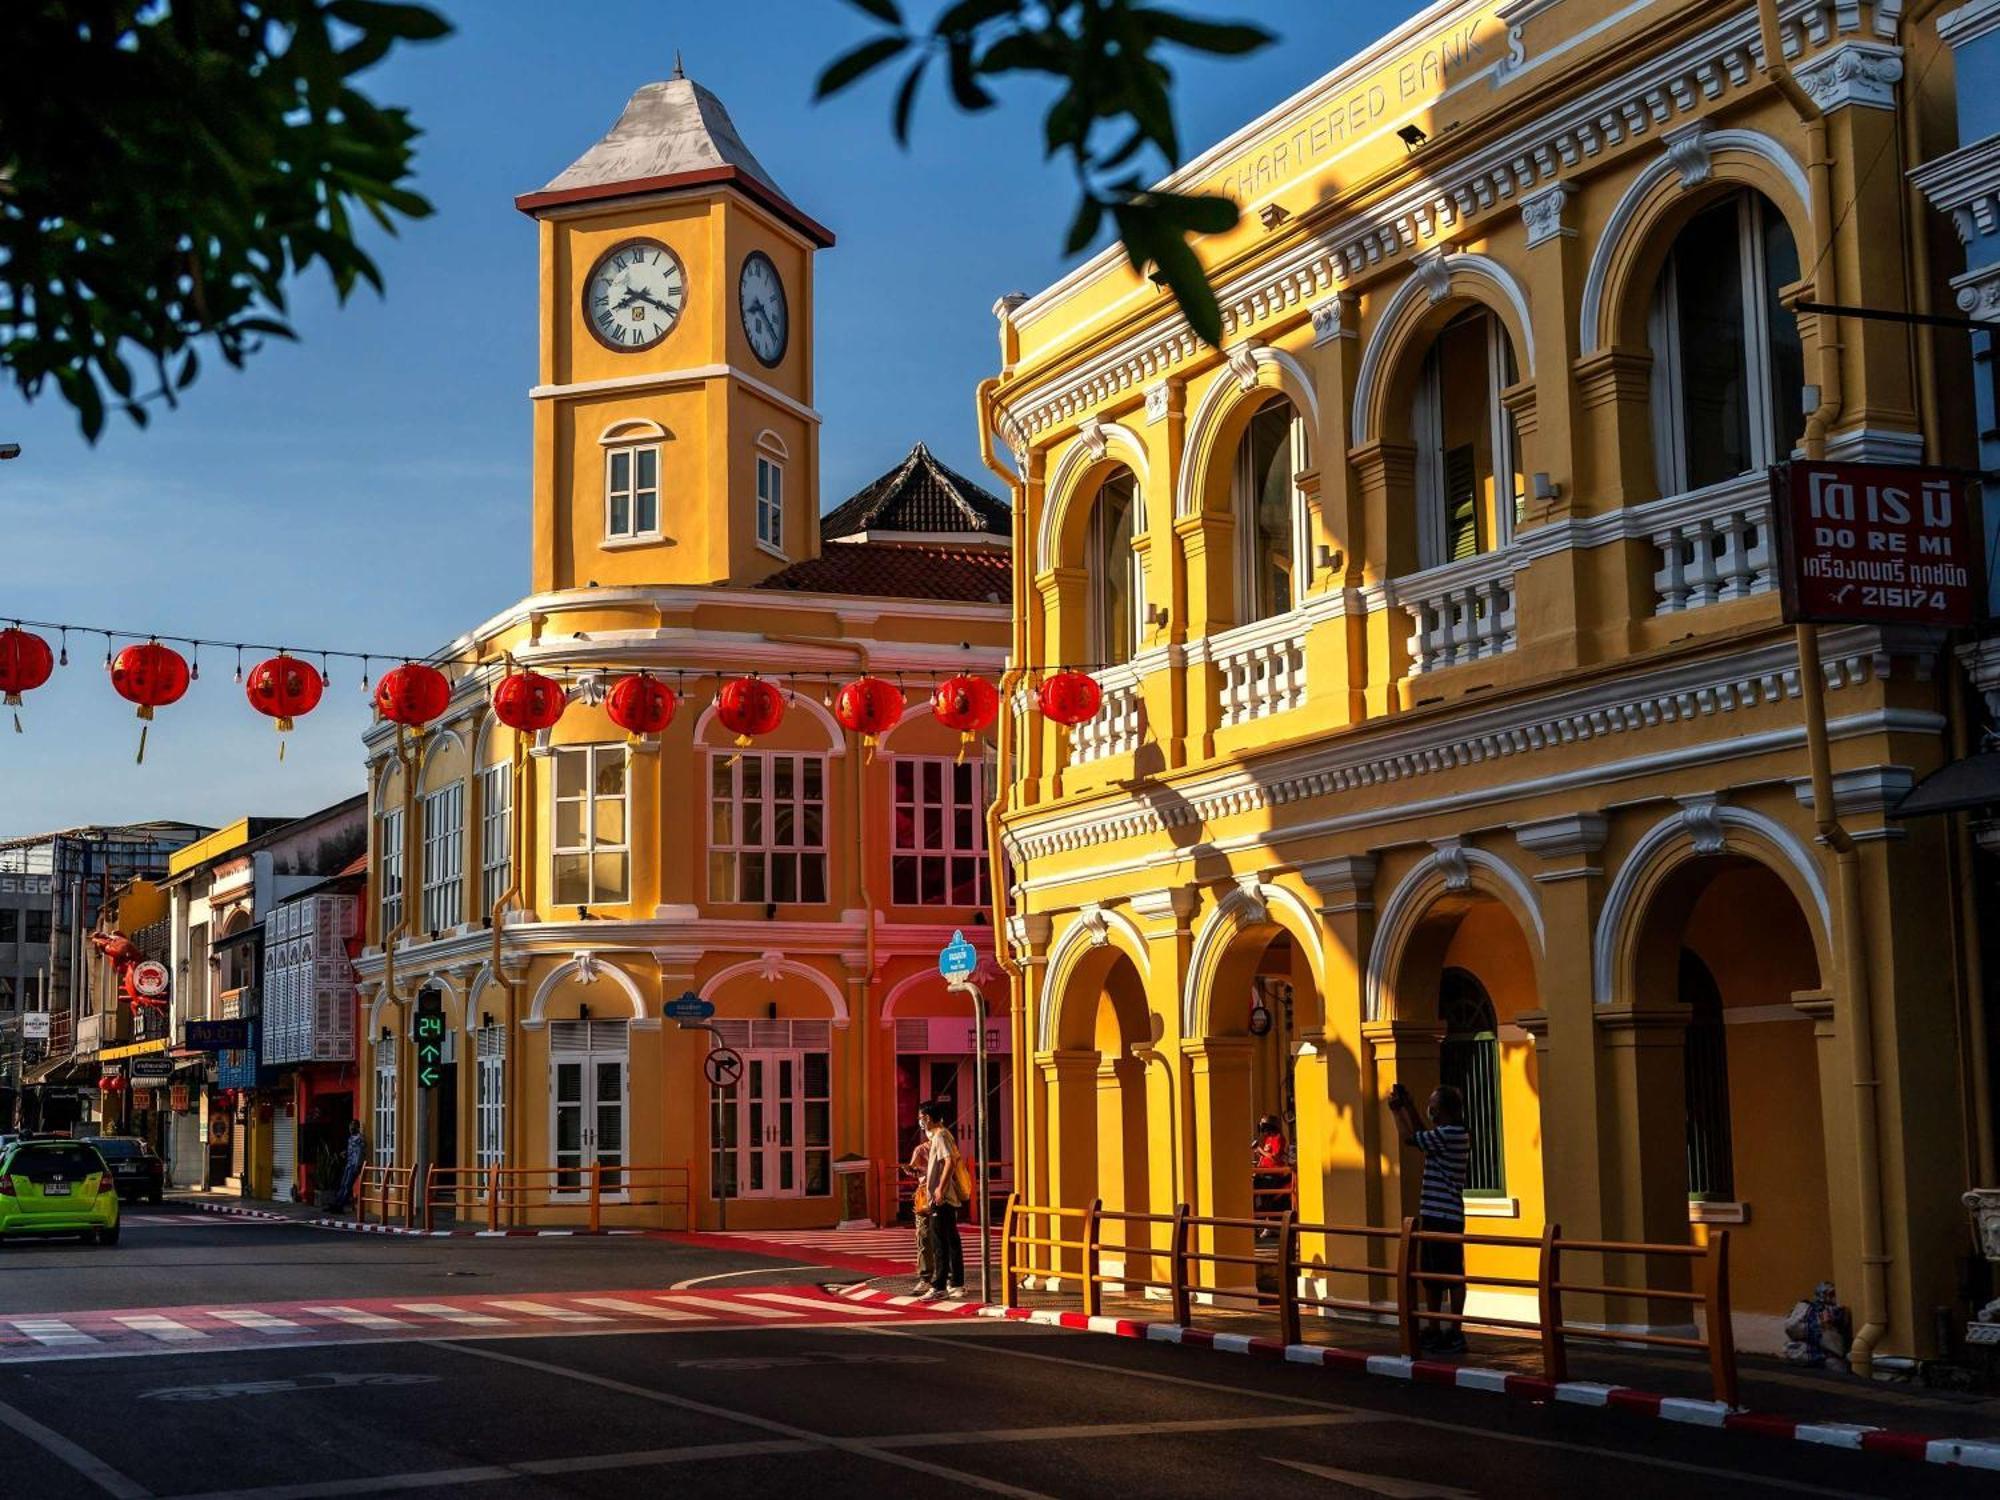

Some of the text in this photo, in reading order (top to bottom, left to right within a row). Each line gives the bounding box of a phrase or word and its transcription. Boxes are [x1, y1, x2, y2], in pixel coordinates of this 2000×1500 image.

[1222, 18, 1484, 201] CHARTERED BANK
[632, 248, 644, 264] XII
[652, 251, 661, 266] I
[663, 265, 677, 278] II
[668, 286, 682, 296] III
[632, 328, 645, 345] VI
[653, 322, 663, 336] V
[1808, 472, 1952, 528] โด เร มี
[1815, 527, 1951, 556] DO RE MI
[1803, 552, 1905, 583] เครื่องดนตรี
[1861, 586, 1947, 610] 215174
[420, 1018, 441, 1037] 24
